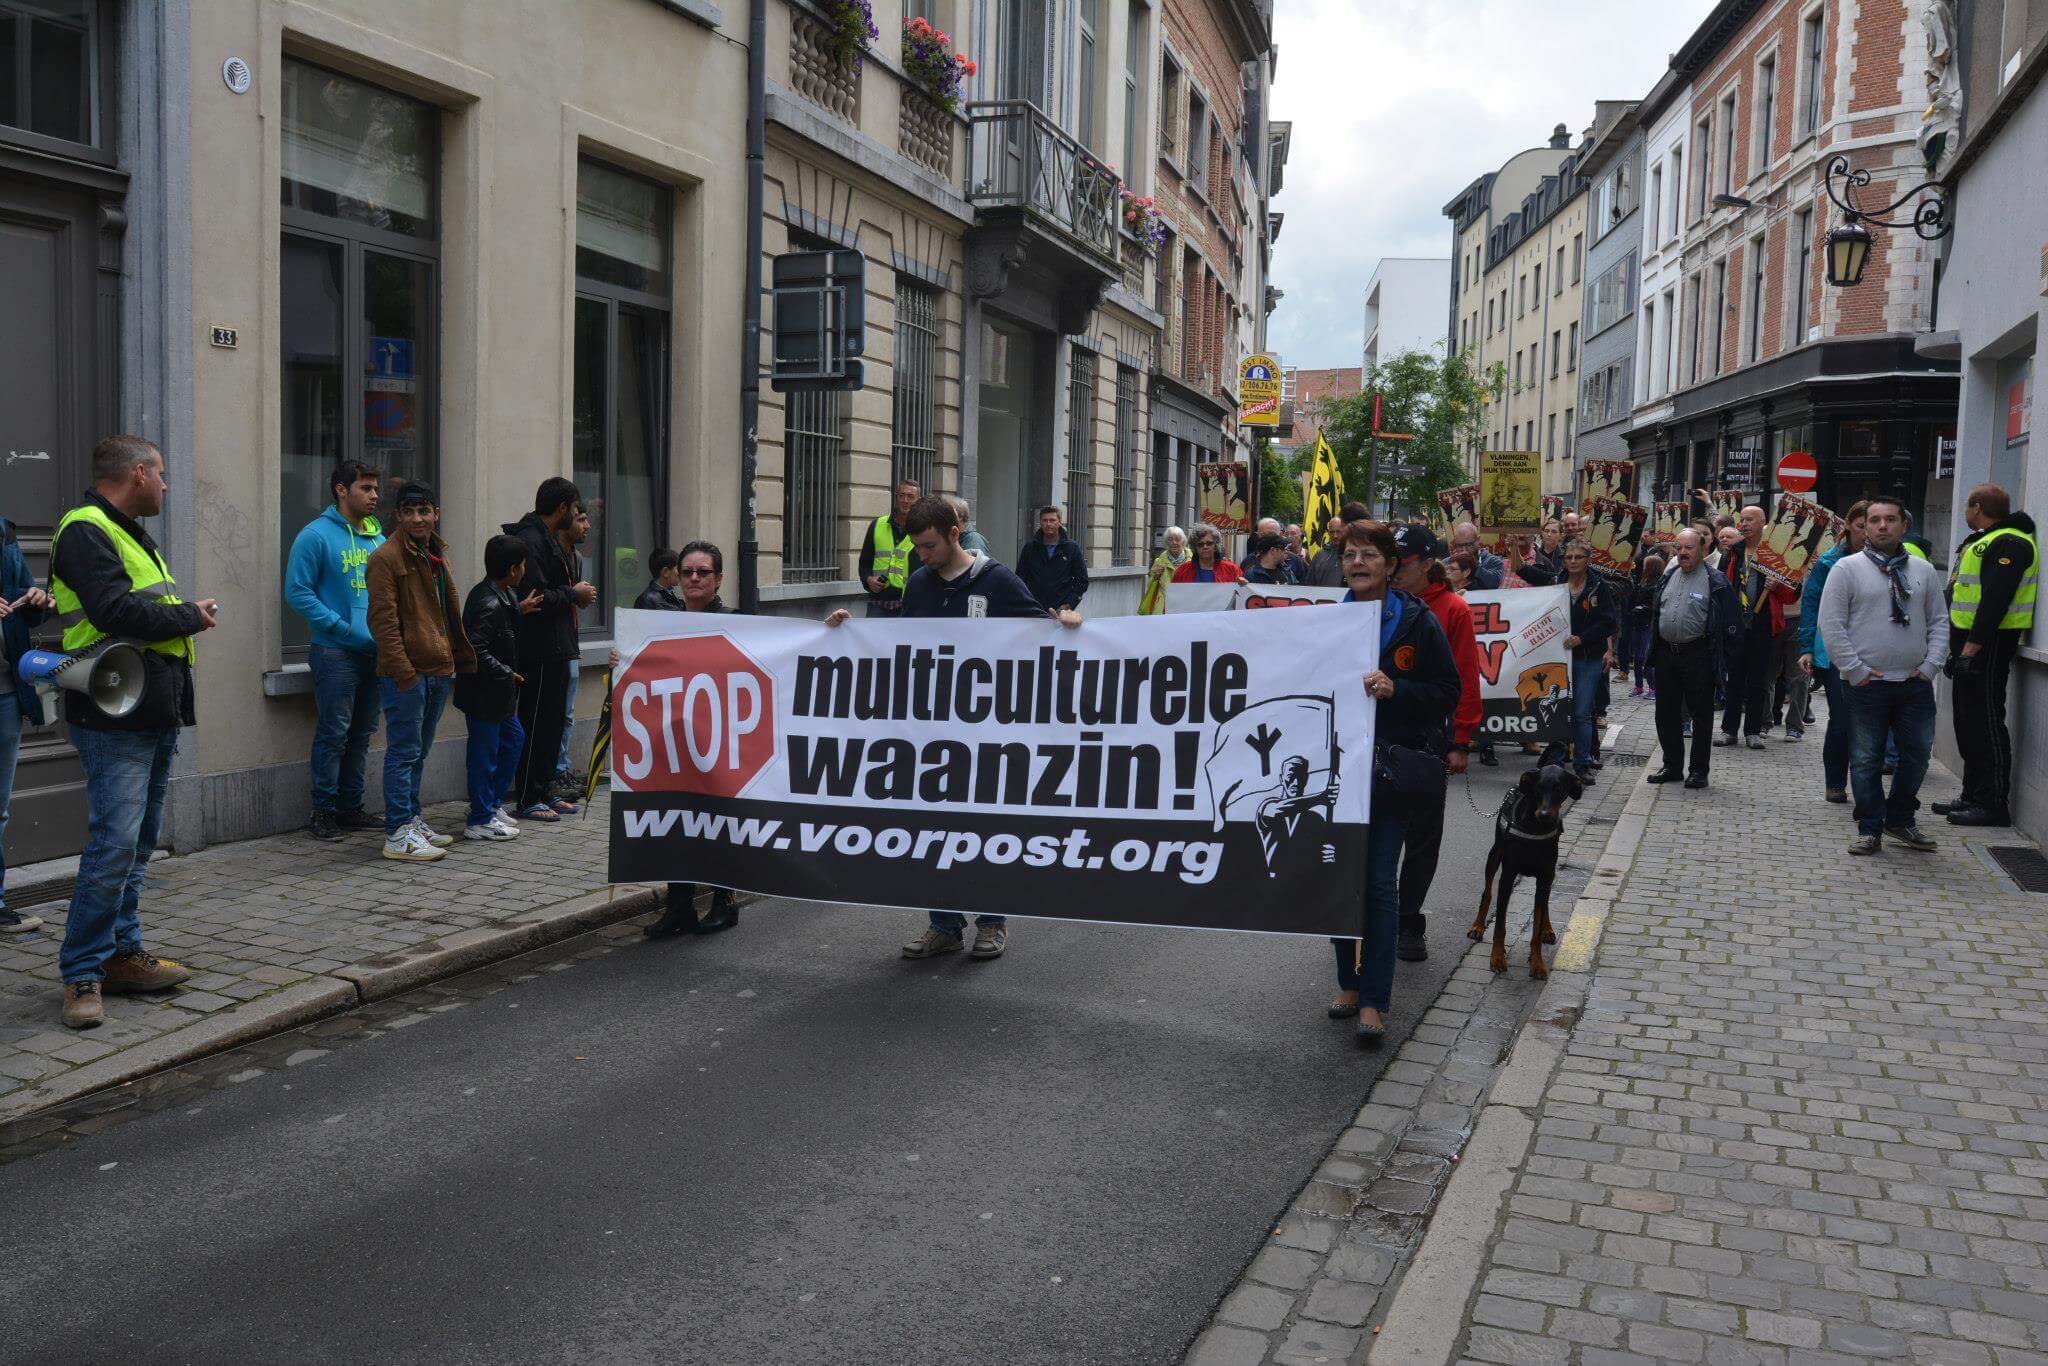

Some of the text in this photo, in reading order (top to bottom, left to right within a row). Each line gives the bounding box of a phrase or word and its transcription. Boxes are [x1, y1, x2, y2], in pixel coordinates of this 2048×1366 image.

[218, 330, 232, 344] 33
[1240, 359, 1279, 379] FIRST IMMO
[1729, 451, 1735, 460] TE
[792, 641, 1249, 726] multiculturele
[621, 670, 762, 780] STOP
[787, 730, 1200, 811] waanzin!
[623, 808, 1225, 885] www.voorpost.org
